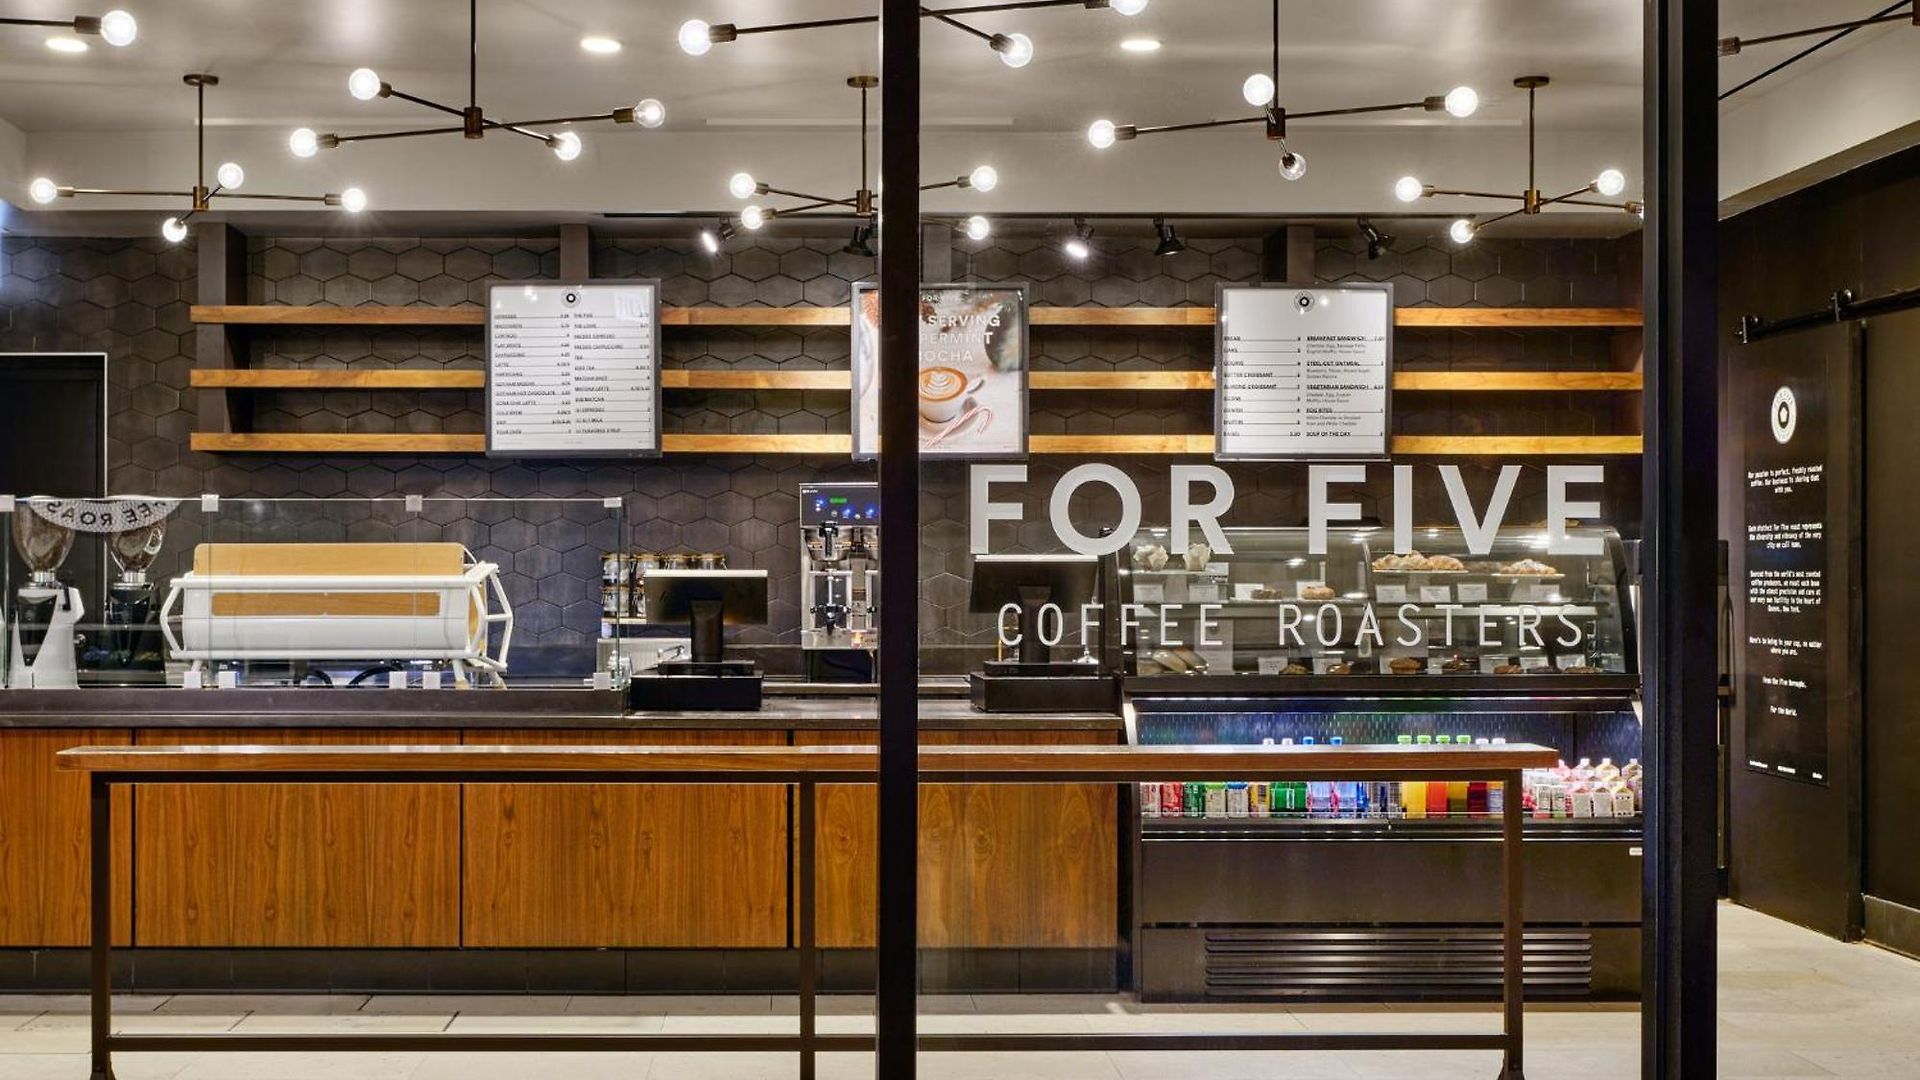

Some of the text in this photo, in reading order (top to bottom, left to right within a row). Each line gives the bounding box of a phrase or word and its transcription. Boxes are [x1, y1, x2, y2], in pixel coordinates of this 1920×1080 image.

[928, 315, 1000, 326] SERVING
[970, 462, 1604, 556] FOR FIVE
[997, 602, 1583, 648] COFFEE ROASTERS
